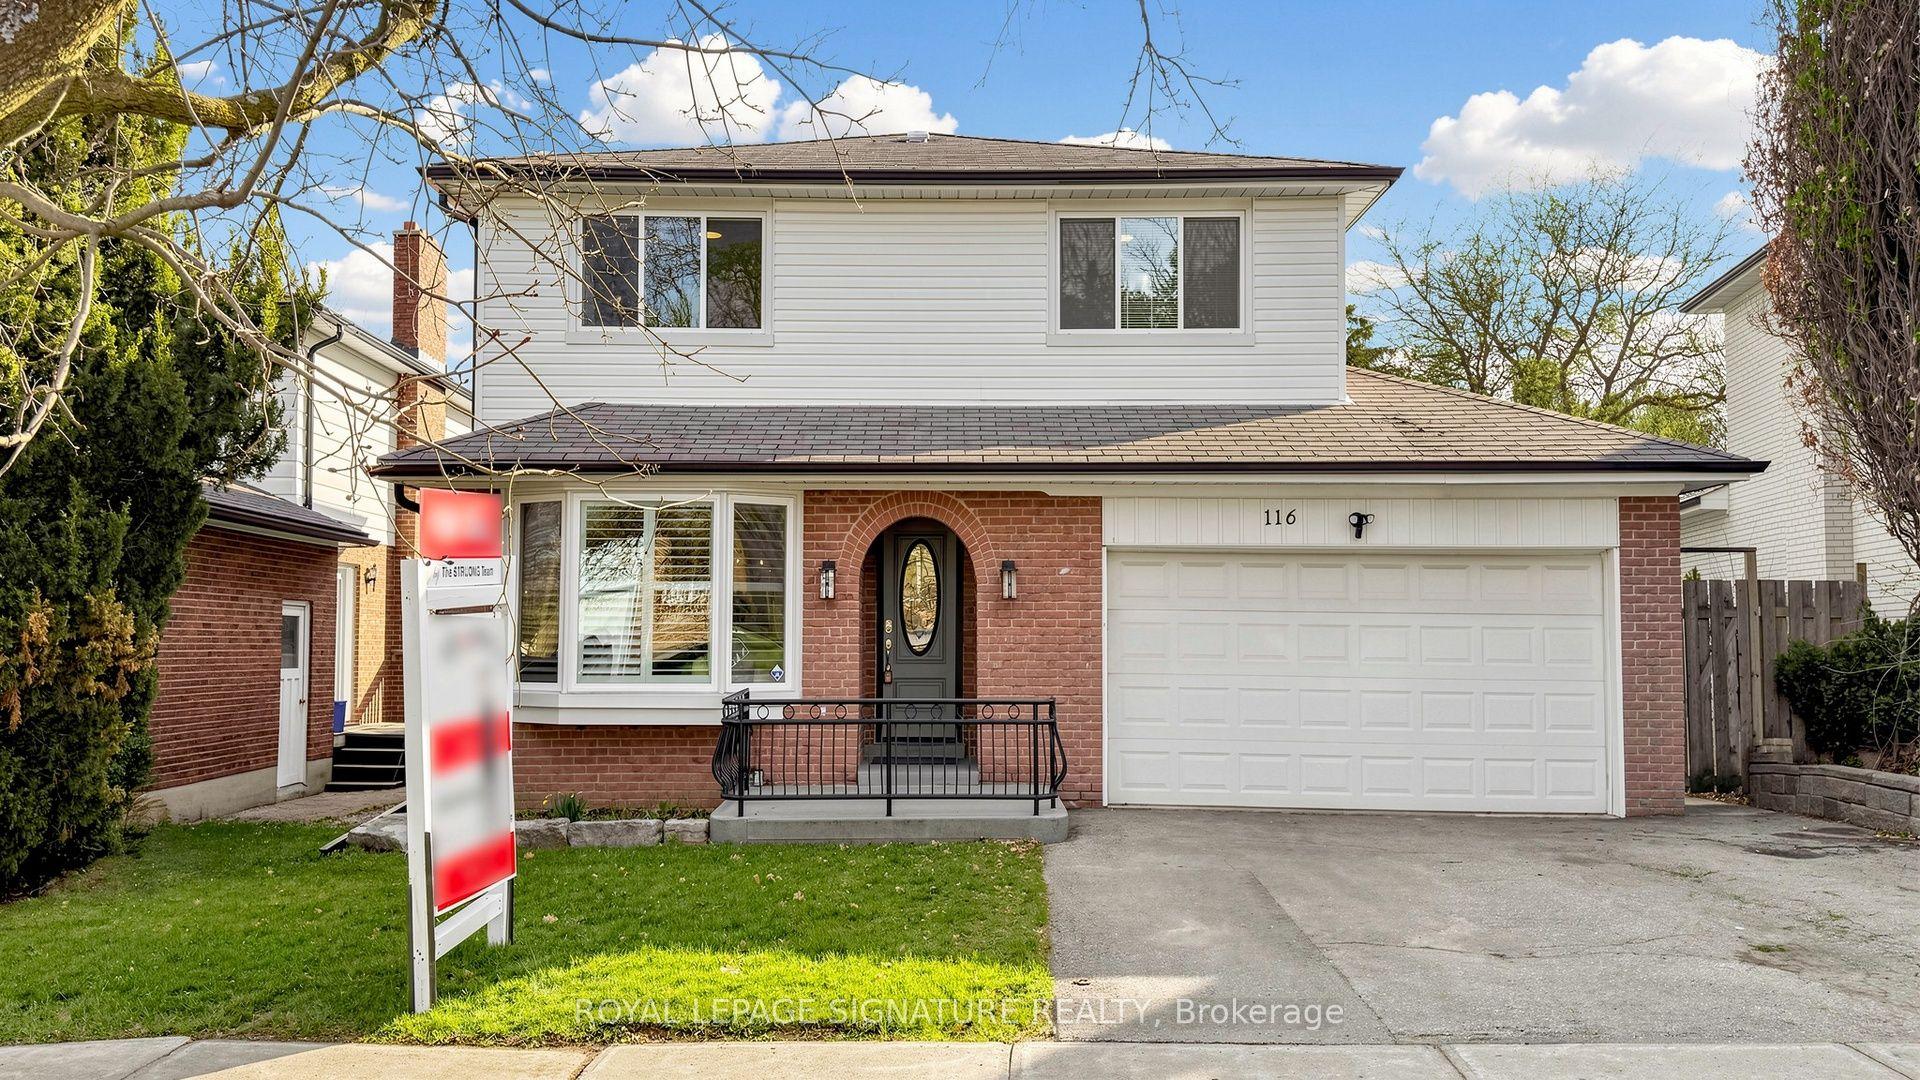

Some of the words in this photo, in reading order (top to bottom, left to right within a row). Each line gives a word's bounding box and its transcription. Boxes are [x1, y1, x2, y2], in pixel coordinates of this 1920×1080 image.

[1264, 509, 1297, 526] 116
[442, 566, 452, 578] The
[481, 565, 494, 577] Team
